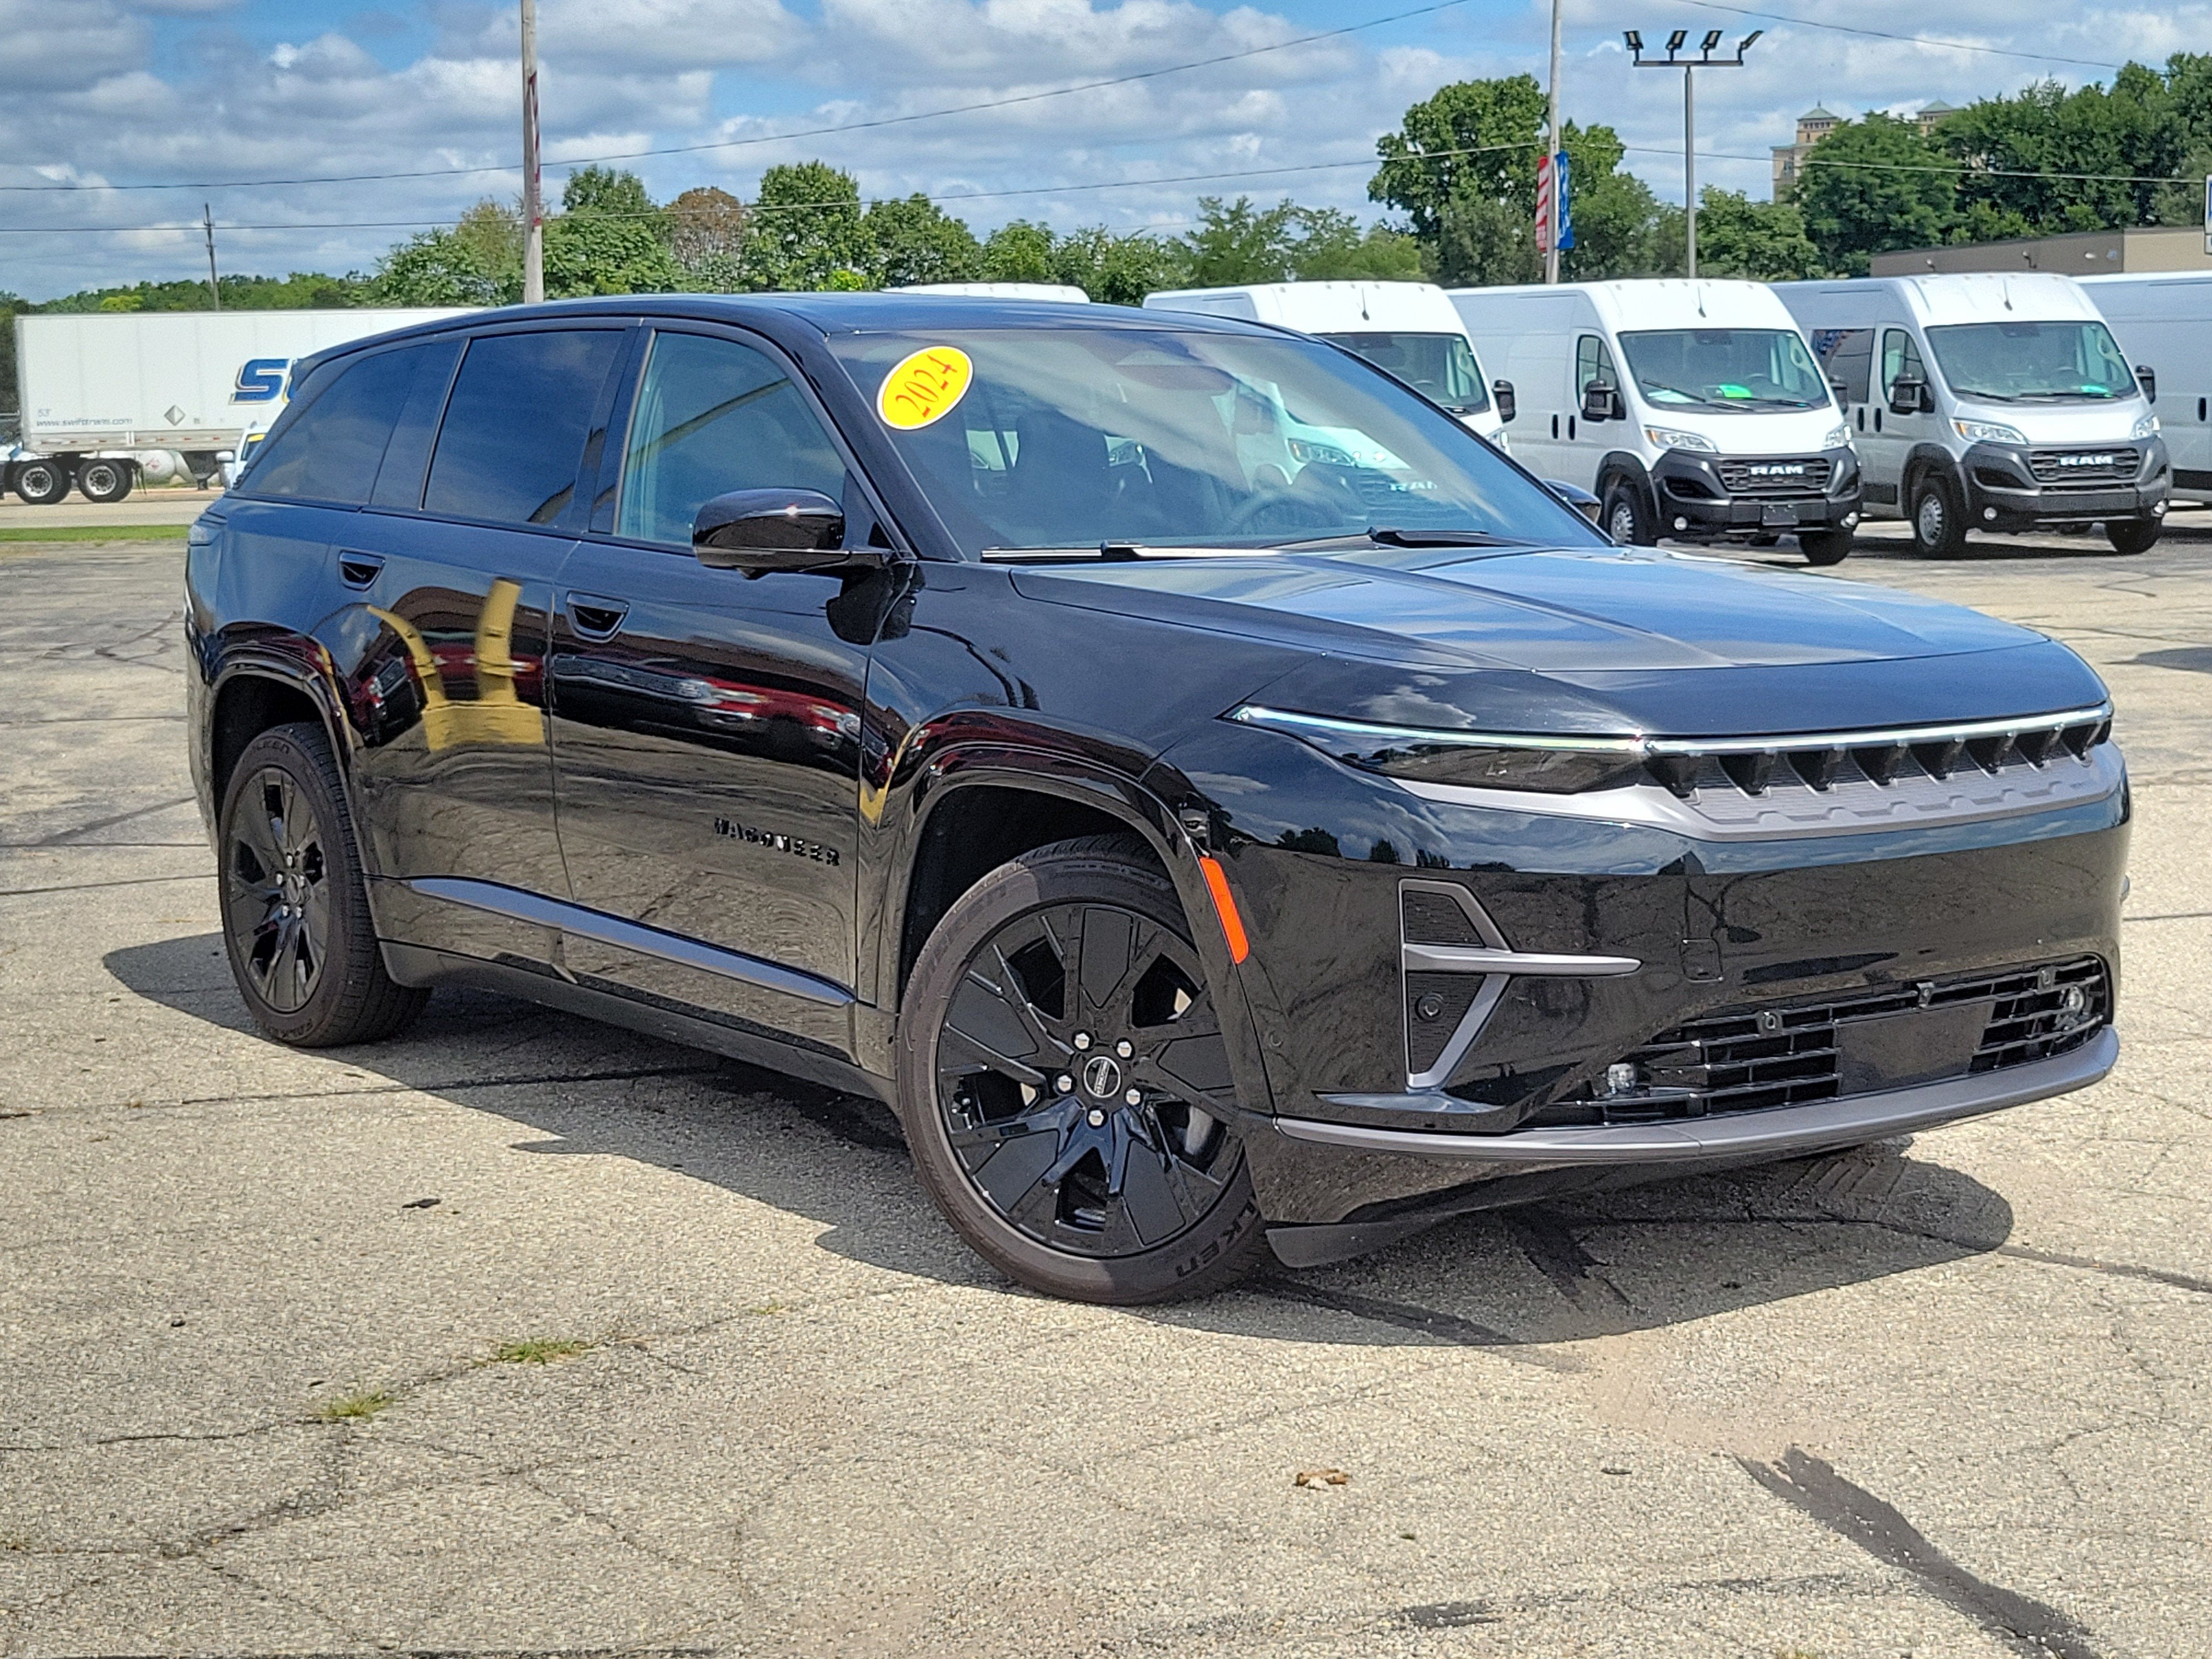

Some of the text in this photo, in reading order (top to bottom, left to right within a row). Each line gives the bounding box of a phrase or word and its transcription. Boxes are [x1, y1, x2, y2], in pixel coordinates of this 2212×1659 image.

[895, 354, 958, 418] 2024
[1750, 464, 1805, 475] RAM
[2059, 454, 2114, 465] RAM
[714, 816, 840, 866] WAGONEER
